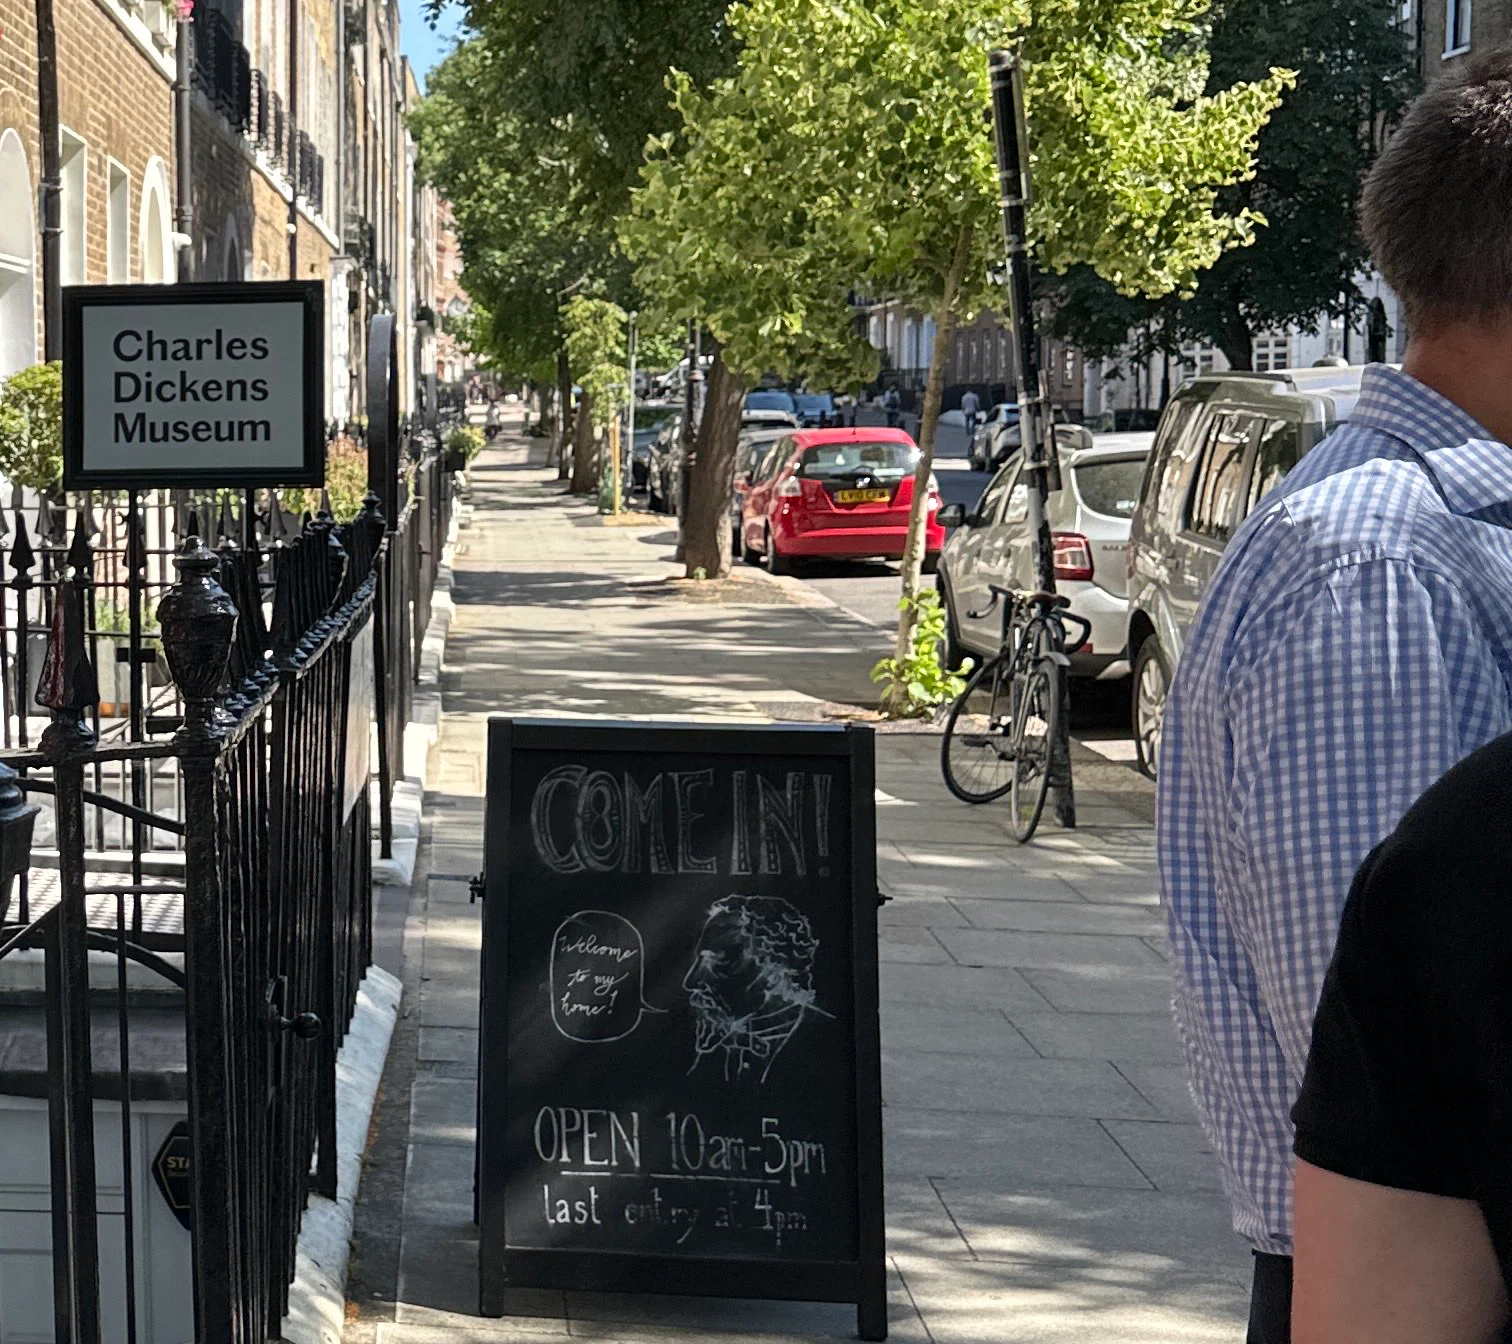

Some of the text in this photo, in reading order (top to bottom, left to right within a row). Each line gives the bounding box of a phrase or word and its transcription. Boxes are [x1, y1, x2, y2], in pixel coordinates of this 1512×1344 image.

[112, 328, 270, 362] Charles
[113, 370, 270, 403] Dickens
[113, 412, 271, 444] Museum
[530, 764, 832, 878] COME IN!
[558, 934, 639, 963] Welcome
[567, 968, 629, 996] to my
[561, 990, 618, 1016] home!
[534, 1106, 826, 1187] OPEN 10am-5pm
[543, 1184, 602, 1225] last
[753, 1187, 808, 1247] 4pm
